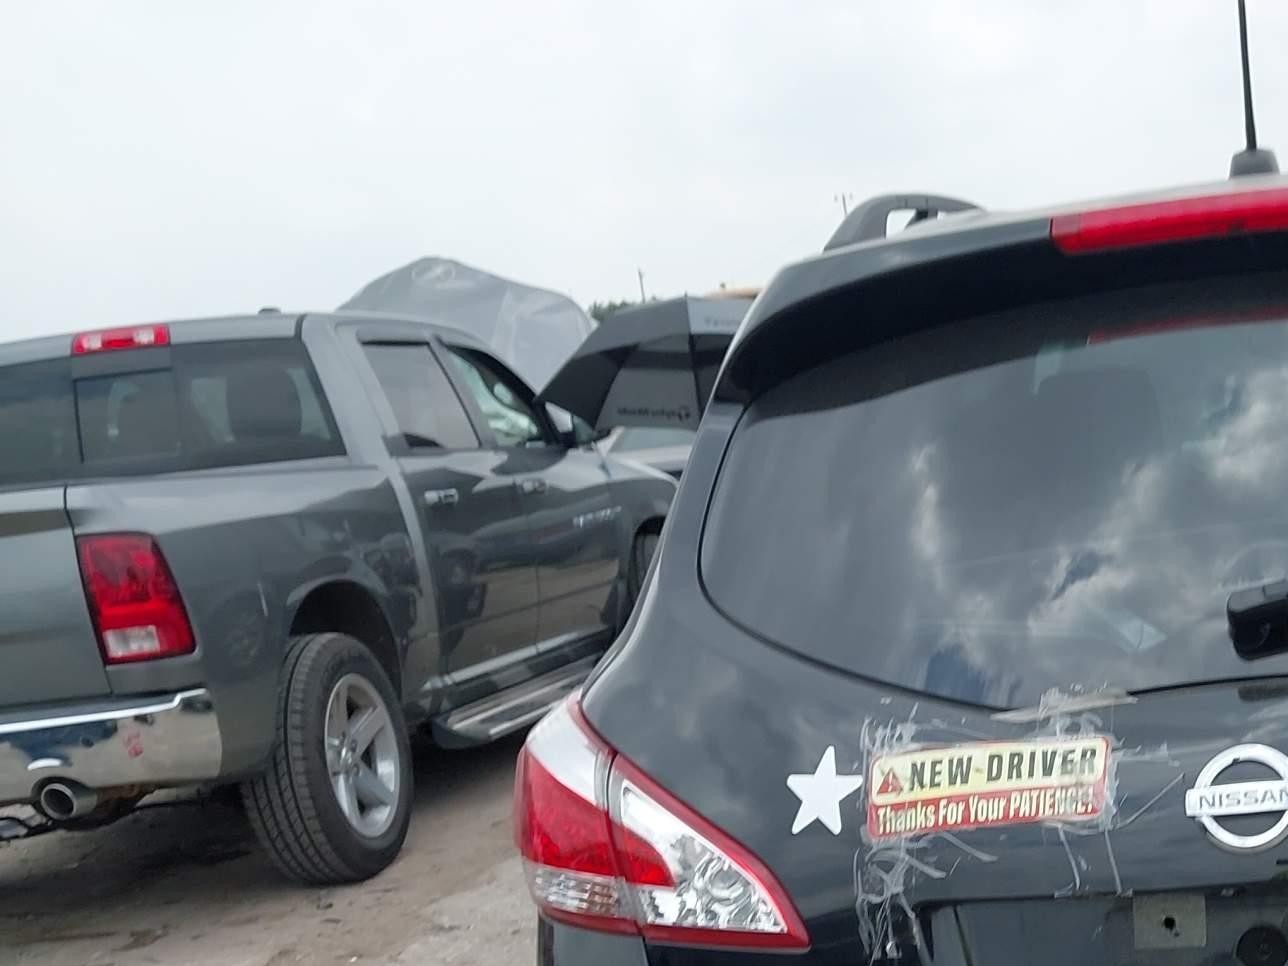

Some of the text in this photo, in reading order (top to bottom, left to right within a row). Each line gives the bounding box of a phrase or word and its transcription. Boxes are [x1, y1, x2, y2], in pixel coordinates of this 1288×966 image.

[910, 748, 1098, 791] NEW DRIVER
[877, 785, 1094, 834] Thanks For Your PATIENCE!
